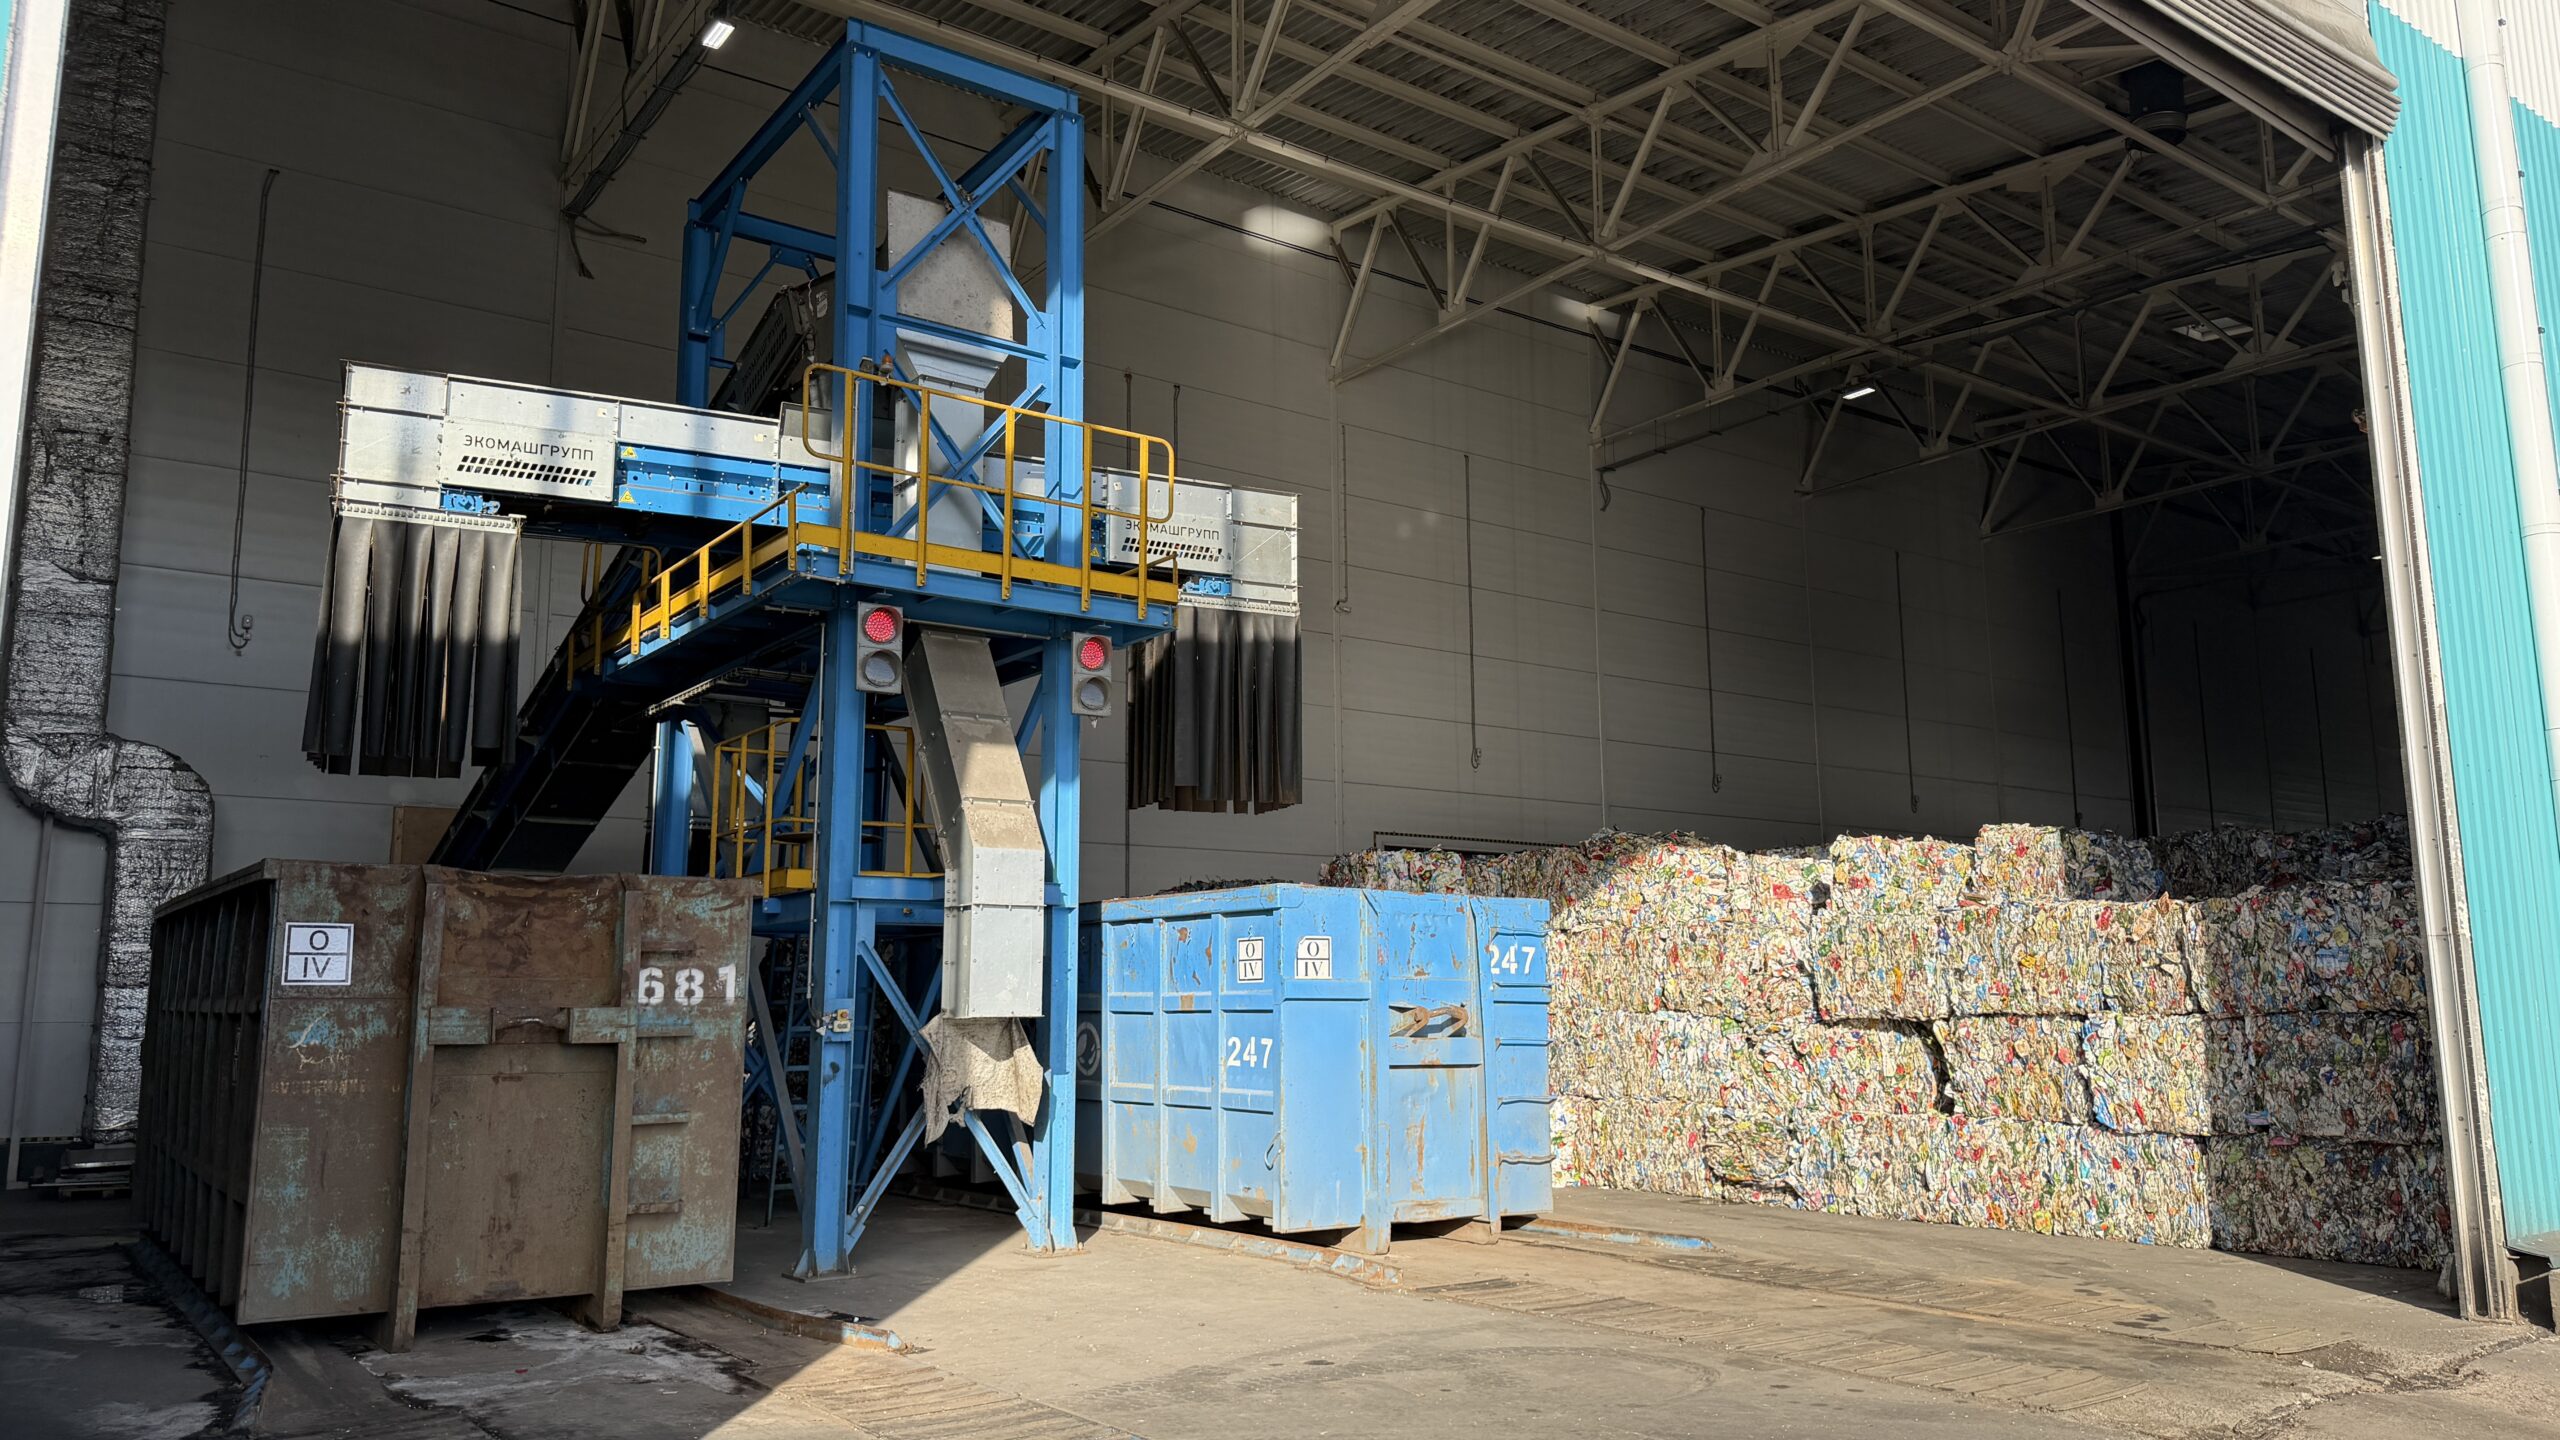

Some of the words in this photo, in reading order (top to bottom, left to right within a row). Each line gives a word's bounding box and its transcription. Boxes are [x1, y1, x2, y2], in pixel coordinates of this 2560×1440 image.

[463, 434, 594, 461] ЭКОМАШГРУПП
[1125, 520, 1220, 540] ЭКМАШГРУПП
[302, 957, 332, 978] IV
[1243, 961, 1258, 978] IV
[1304, 961, 1323, 977] IV
[1489, 944, 1536, 975] 247
[638, 963, 737, 1006] 681
[1227, 1036, 1273, 1069] 247
